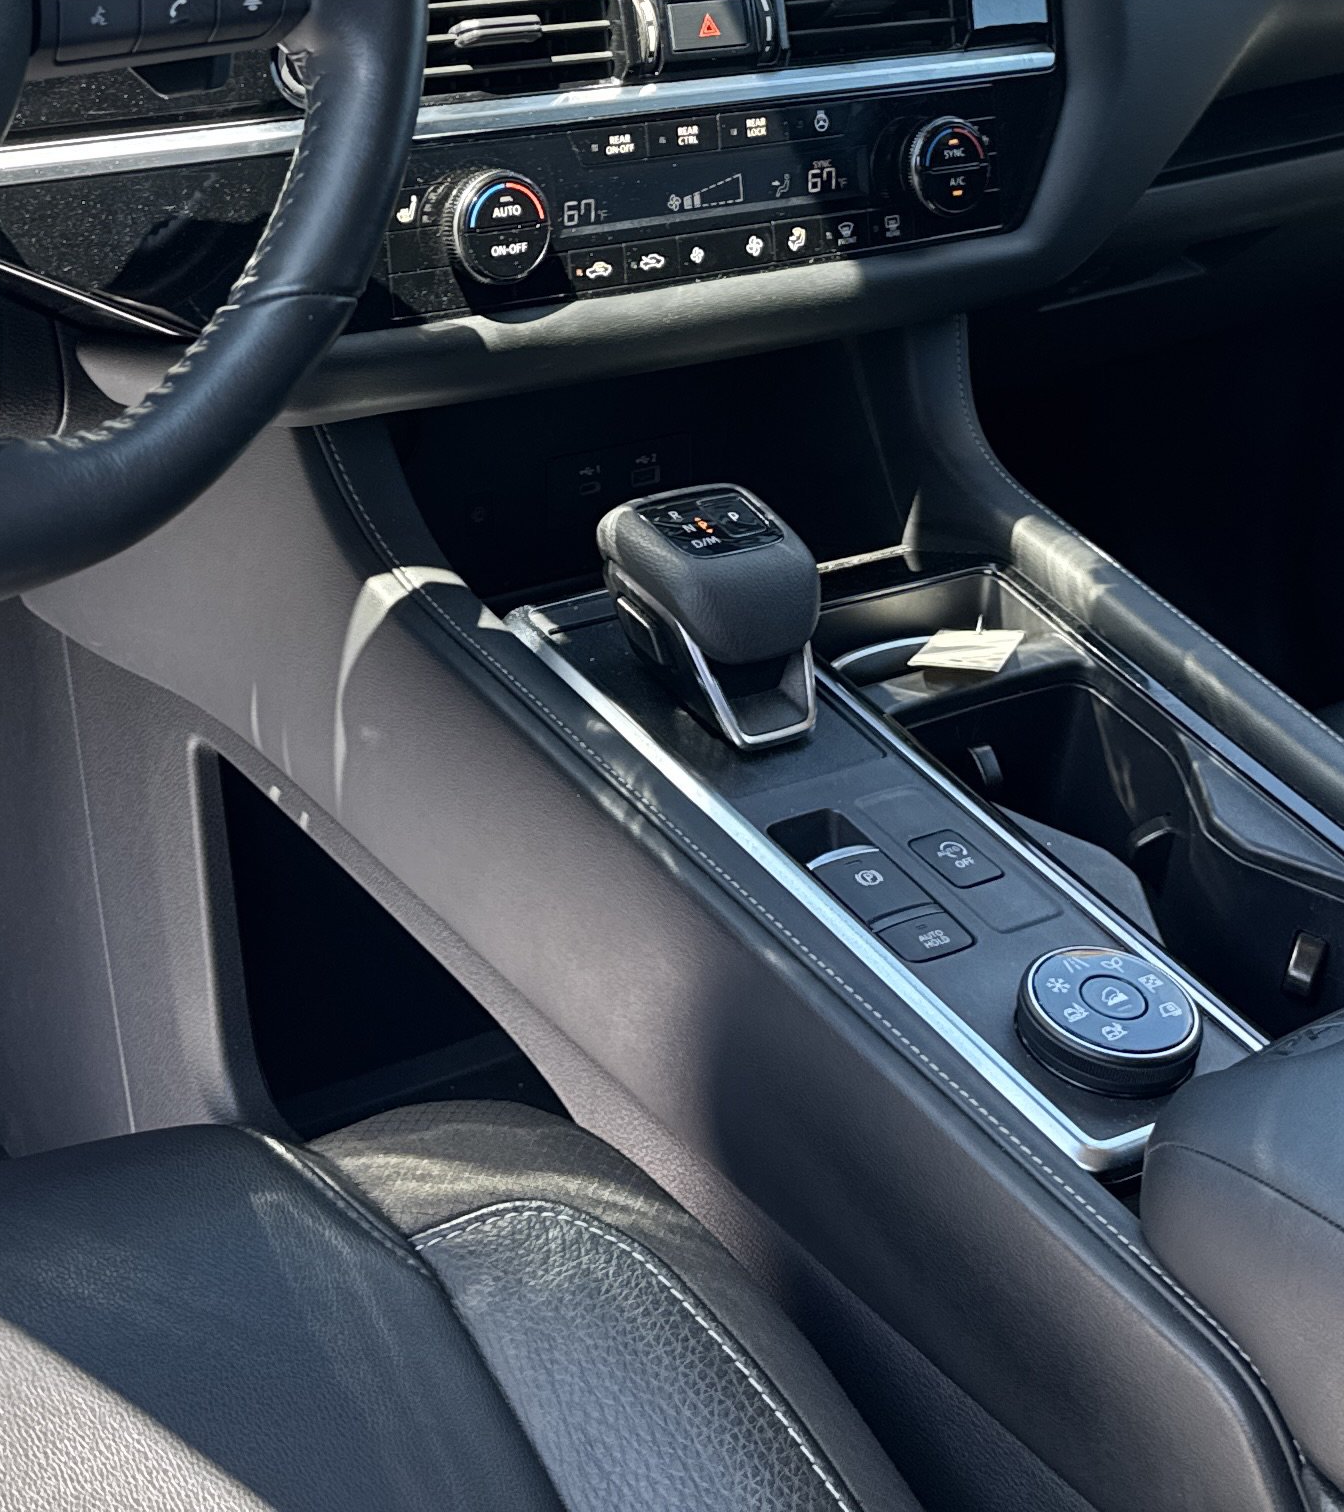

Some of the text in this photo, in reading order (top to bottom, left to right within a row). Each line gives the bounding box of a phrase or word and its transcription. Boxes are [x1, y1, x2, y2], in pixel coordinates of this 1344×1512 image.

[745, 117, 767, 128] REAR
[677, 125, 699, 136] REAR
[746, 126, 768, 137] LOCK
[608, 133, 632, 145] REAR
[677, 135, 699, 146] CTRL
[943, 148, 966, 160] SYNC
[949, 175, 966, 186] A/C
[492, 204, 523, 219] AUTO
[490, 241, 529, 257] ON-OFF
[667, 510, 683, 522] R
[727, 511, 740, 522] P
[682, 523, 698, 533] N
[690, 535, 722, 549] D/M
[954, 856, 976, 869] OFF
[918, 929, 944, 943] AUTO
[922, 935, 951, 949] HOLD
